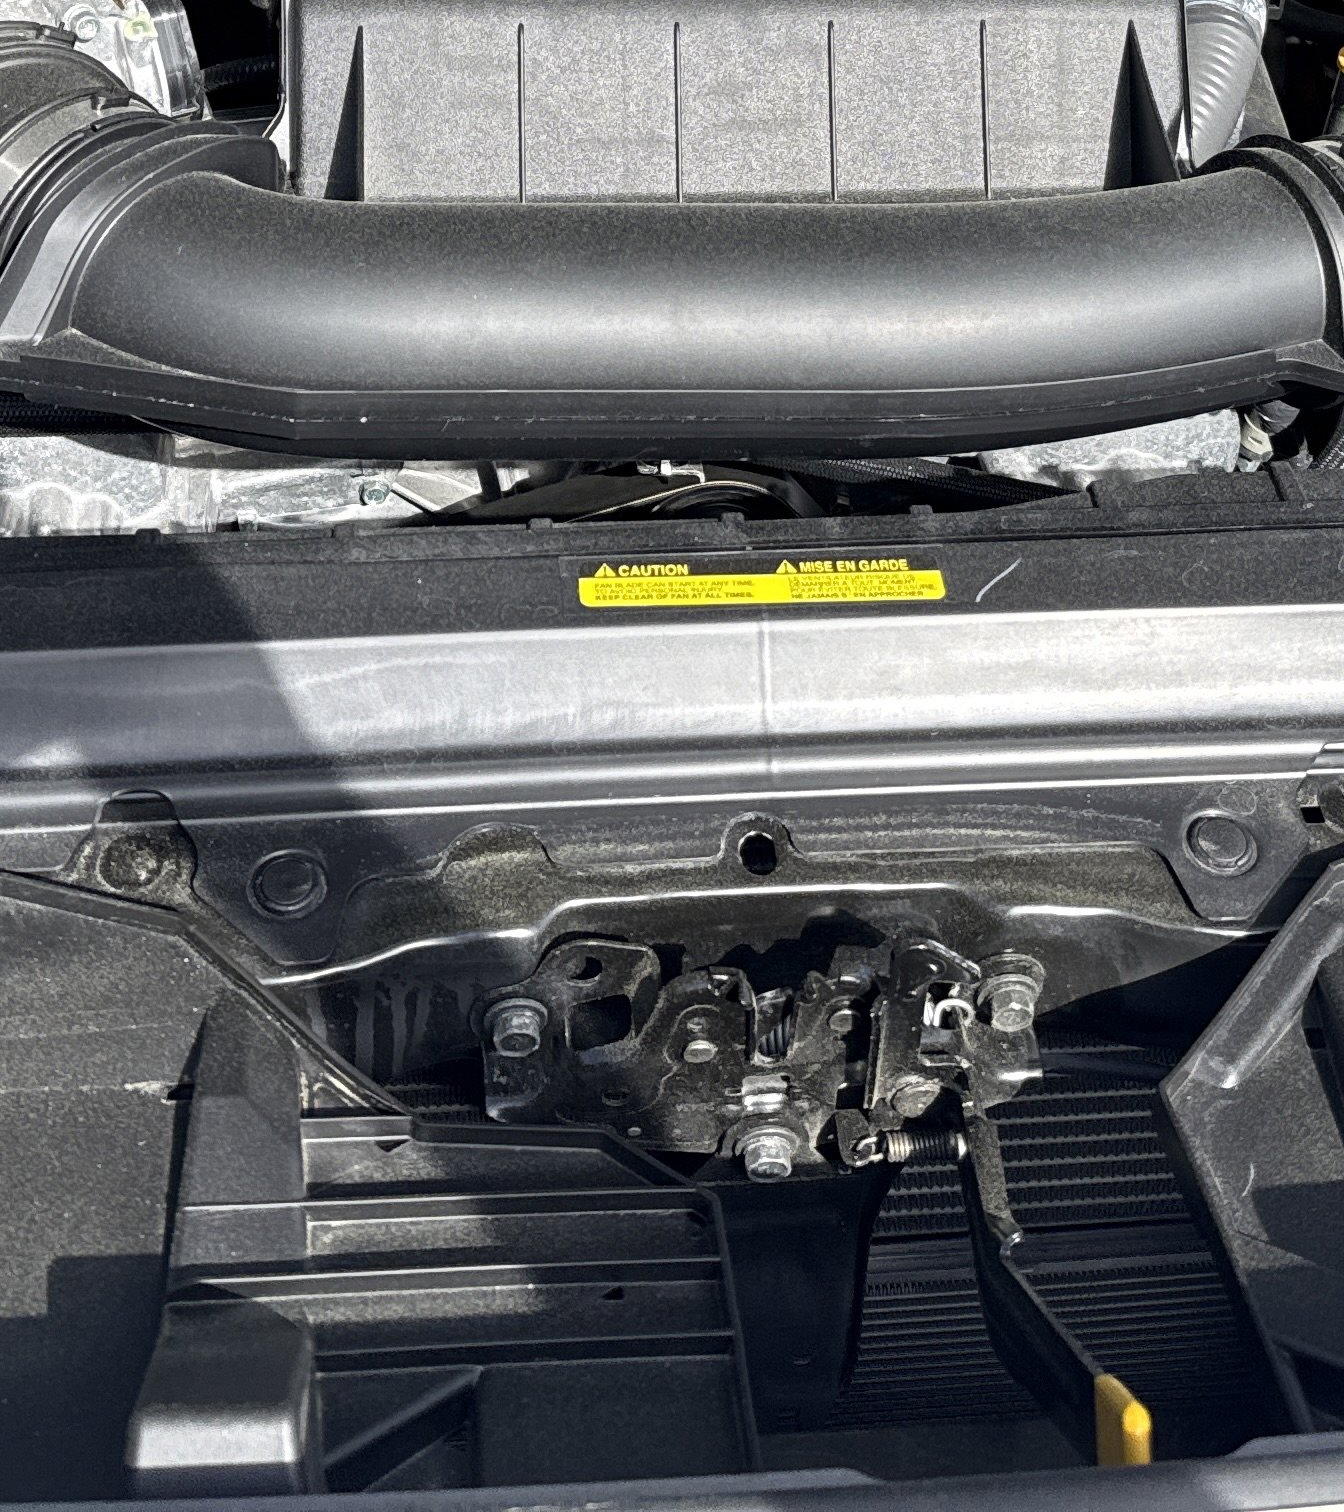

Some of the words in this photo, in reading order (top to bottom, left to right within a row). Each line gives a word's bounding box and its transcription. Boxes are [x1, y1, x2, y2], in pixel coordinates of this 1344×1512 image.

[618, 564, 689, 576] CAUTION
[799, 561, 833, 572] MISE
[836, 560, 856, 572] EN
[859, 559, 908, 571] GARDE
